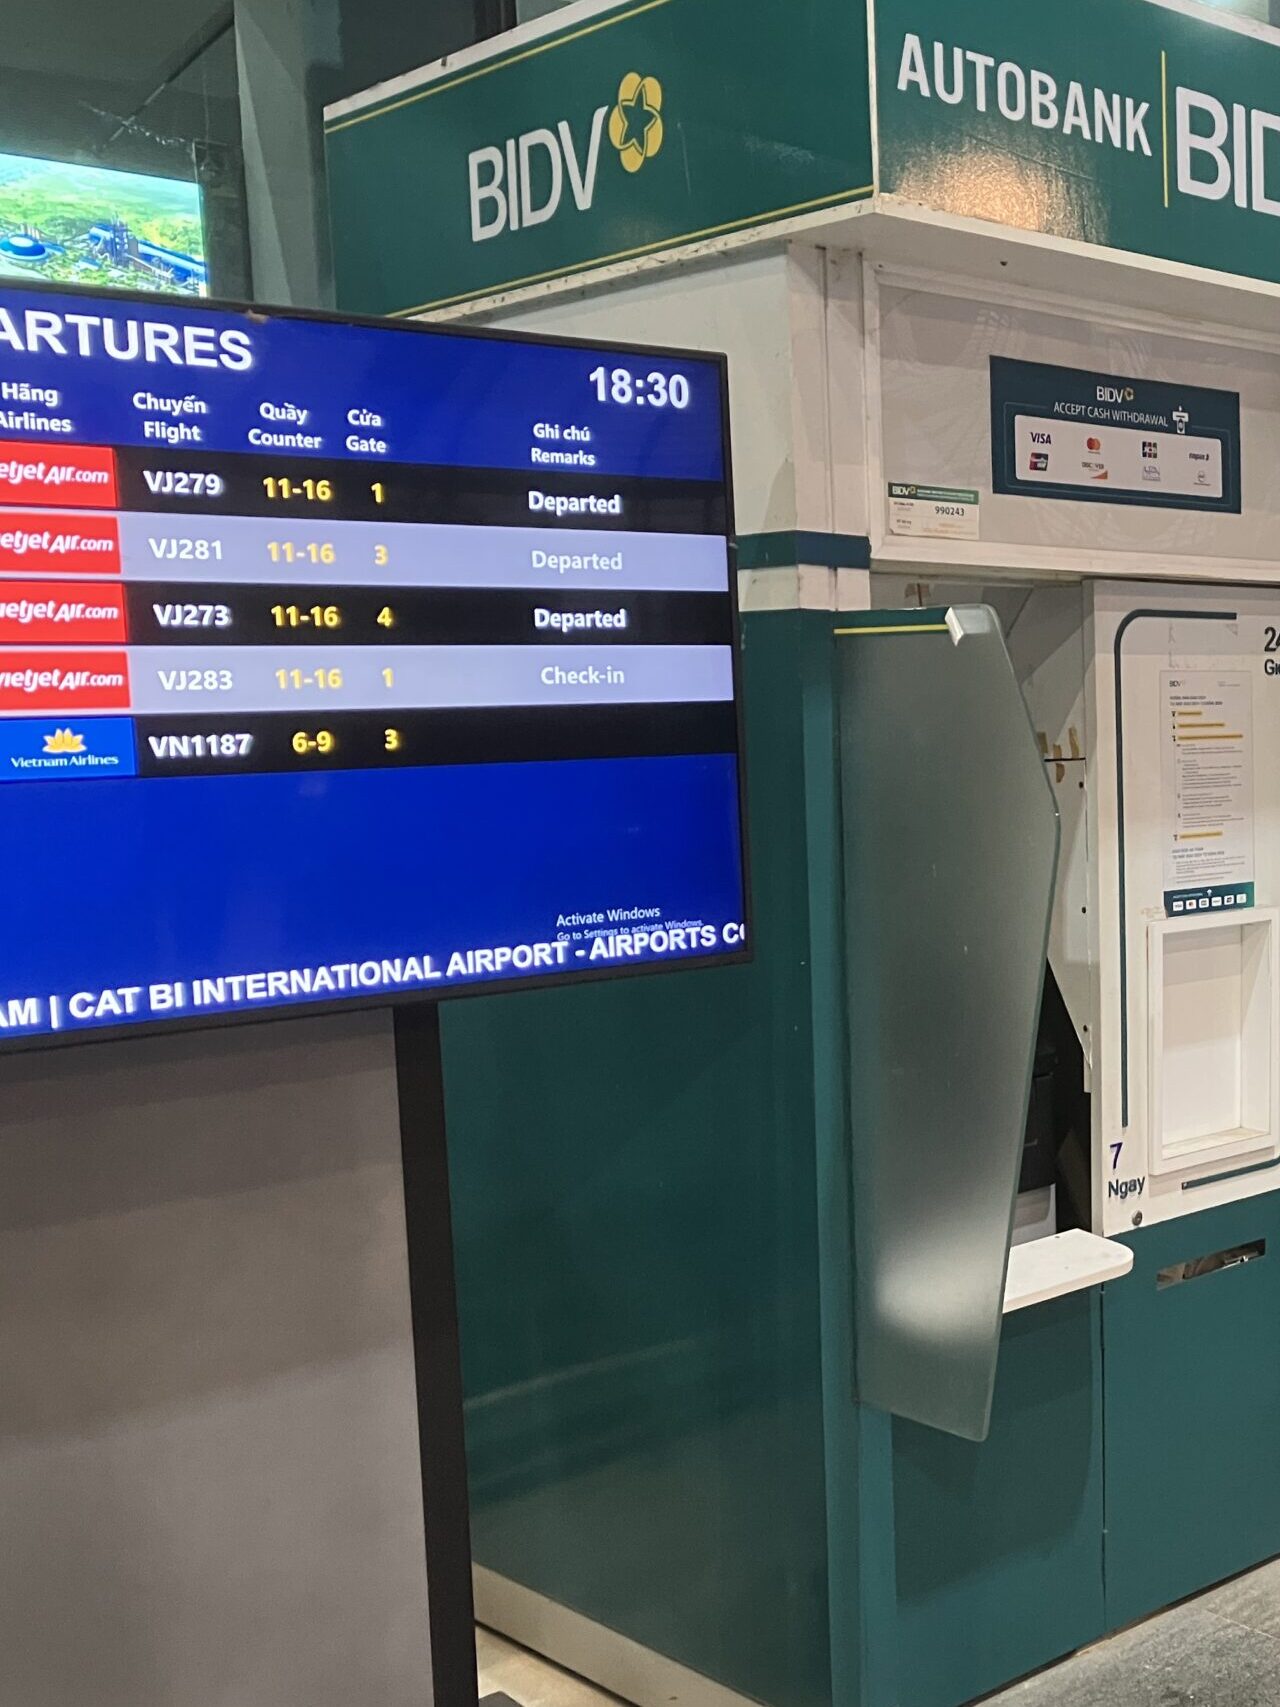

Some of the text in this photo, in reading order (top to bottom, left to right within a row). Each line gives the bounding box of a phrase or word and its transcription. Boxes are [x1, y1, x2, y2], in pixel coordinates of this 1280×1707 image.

[896, 33, 1153, 157] AUTOBANK
[467, 104, 609, 243] BIDV
[0, 305, 255, 371] ARTURES
[1, 382, 60, 408] Hãng
[589, 366, 690, 410] 18:30
[1096, 385, 1125, 404] BIDV
[132, 391, 208, 417] Chuyến
[259, 402, 309, 426] Quầy
[1053, 401, 1169, 428] ACCEPT CASH WITHDRAWAL
[0, 410, 73, 433] Airlines
[347, 409, 382, 427] Cửa
[143, 420, 202, 445] Flight
[247, 427, 323, 449] Counter
[345, 434, 388, 453] Gate
[533, 422, 591, 442] Ghi chú
[1030, 431, 1052, 445] VISA
[531, 446, 596, 466] Remarks
[143, 470, 225, 496] VJ279
[263, 476, 334, 502] 11-16
[371, 482, 385, 504] 1
[891, 485, 911, 496] BIDV
[528, 490, 622, 517] Departed
[934, 505, 965, 517] 990243
[148, 538, 225, 561] VJ281
[267, 541, 337, 566] 11-16
[374, 543, 389, 567] 3
[531, 549, 624, 575] Departed
[152, 603, 232, 628] VJ273
[271, 605, 342, 629] 11-16
[376, 606, 395, 629] 4
[534, 607, 628, 634] Departed
[157, 670, 234, 691] VJ283
[275, 667, 344, 690] 11-16
[382, 667, 395, 688] 1
[540, 665, 625, 686] Check-in
[147, 733, 254, 758] VN1187
[292, 730, 333, 754] 6-9
[384, 728, 400, 750] 3
[10, 753, 119, 769] Vietnam Airlines
[556, 905, 661, 928] Activate Windows
[556, 931, 571, 943] Go
[572, 930, 583, 941] to
[583, 926, 619, 941] Settings
[619, 925, 630, 935] to
[631, 921, 664, 935] activate
[68, 986, 142, 1019] CAT
[149, 981, 184, 1011] BI
[192, 954, 441, 1006] INTERNATIONAL
[446, 940, 570, 977] AIRPORT
[588, 924, 718, 962] AIRPORTS
[1109, 1141, 1123, 1170] 7
